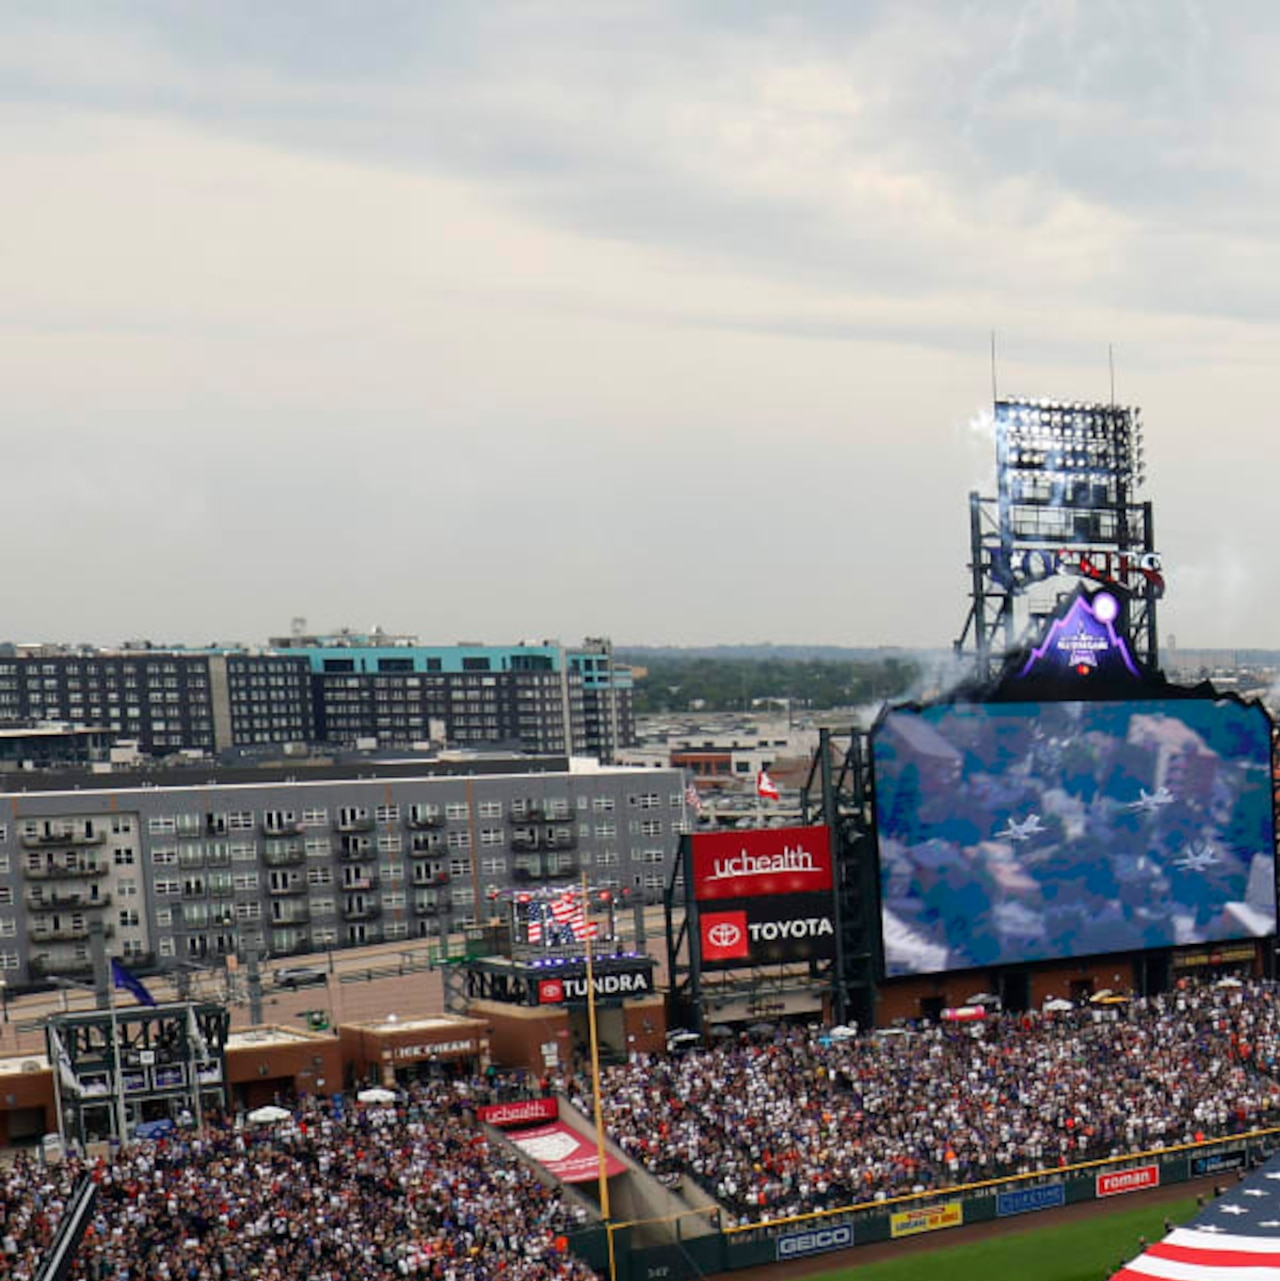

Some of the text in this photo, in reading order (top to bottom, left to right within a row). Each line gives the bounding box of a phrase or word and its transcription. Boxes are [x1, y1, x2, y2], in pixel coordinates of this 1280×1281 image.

[714, 846, 813, 877] uchealth
[748, 917, 834, 942] TOYOTA
[562, 973, 648, 998] TUNDRA
[1103, 1169, 1150, 1193] roman
[778, 1226, 851, 1255] GEICO
